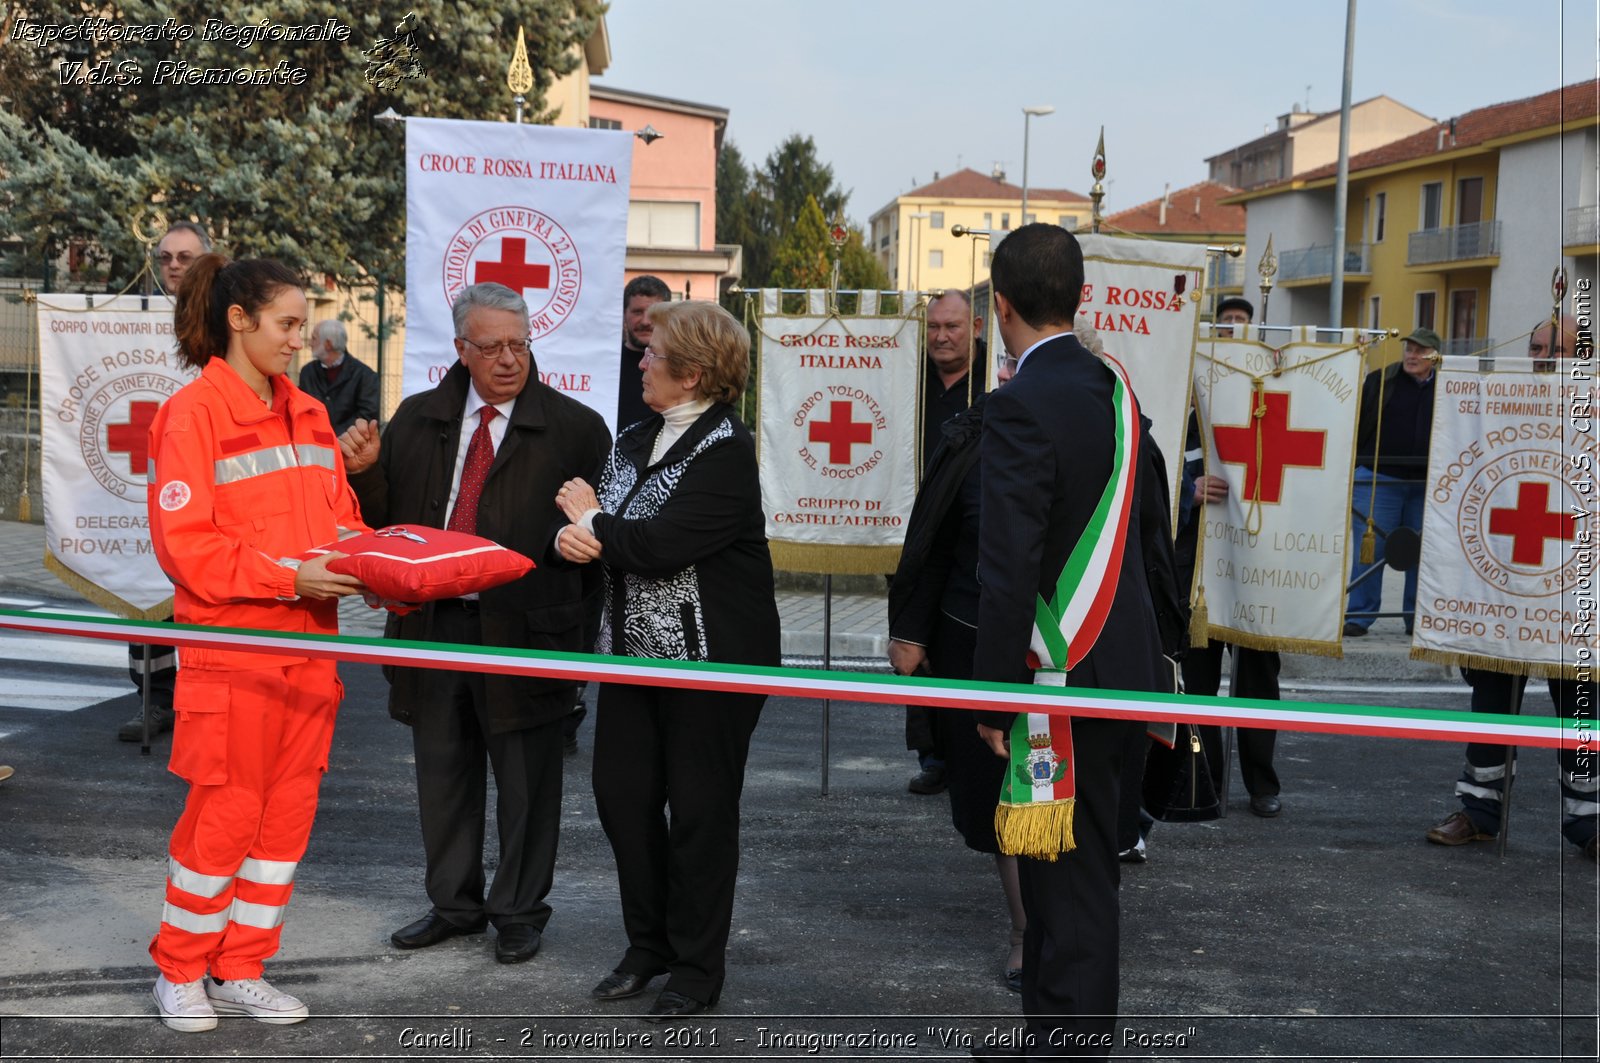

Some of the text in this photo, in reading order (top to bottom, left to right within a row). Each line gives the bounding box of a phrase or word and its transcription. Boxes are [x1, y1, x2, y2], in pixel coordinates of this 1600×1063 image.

[420, 154, 617, 183] CROCE ROSSA ITALIANA
[468, 220, 487, 239] DI
[489, 210, 553, 239] GINEVRA
[552, 237, 570, 254] 22
[551, 259, 578, 316] AGOSTO
[1105, 286, 1181, 312] ROSSA
[51, 320, 88, 333] CORPO
[92, 321, 151, 335] VOLONTARI
[780, 334, 900, 349] CROCE ROSSA
[800, 354, 882, 369] ITALIANA
[58, 365, 101, 423] CROCE
[102, 349, 167, 372] ROSSA
[1294, 355, 1353, 404] ITALIANA
[1486, 383, 1551, 399] VOLONTARI
[794, 385, 887, 431] CORPO VOLONTARI
[1485, 402, 1552, 417] FEMMINILE
[83, 376, 174, 496] CONVENZIONE DI GINEVRA
[798, 447, 883, 479] DEL SOCCORSO
[1433, 440, 1484, 503] CROCE
[1486, 423, 1563, 449] ROSSA
[798, 497, 882, 511] GRUPPO DI
[774, 513, 902, 527] CASTELL'ALFERO
[1463, 484, 1509, 586] CONVENZIONE
[1486, 465, 1503, 481] DI
[1509, 455, 1582, 481] GINEVRA
[61, 538, 127, 554] PIOVA'
[1274, 532, 1343, 554] LOCALE
[1241, 566, 1320, 590] DAMIANO
[1434, 598, 1518, 619] COMITATO
[1421, 615, 1486, 637] BORGO
[1494, 624, 1510, 640] S.
